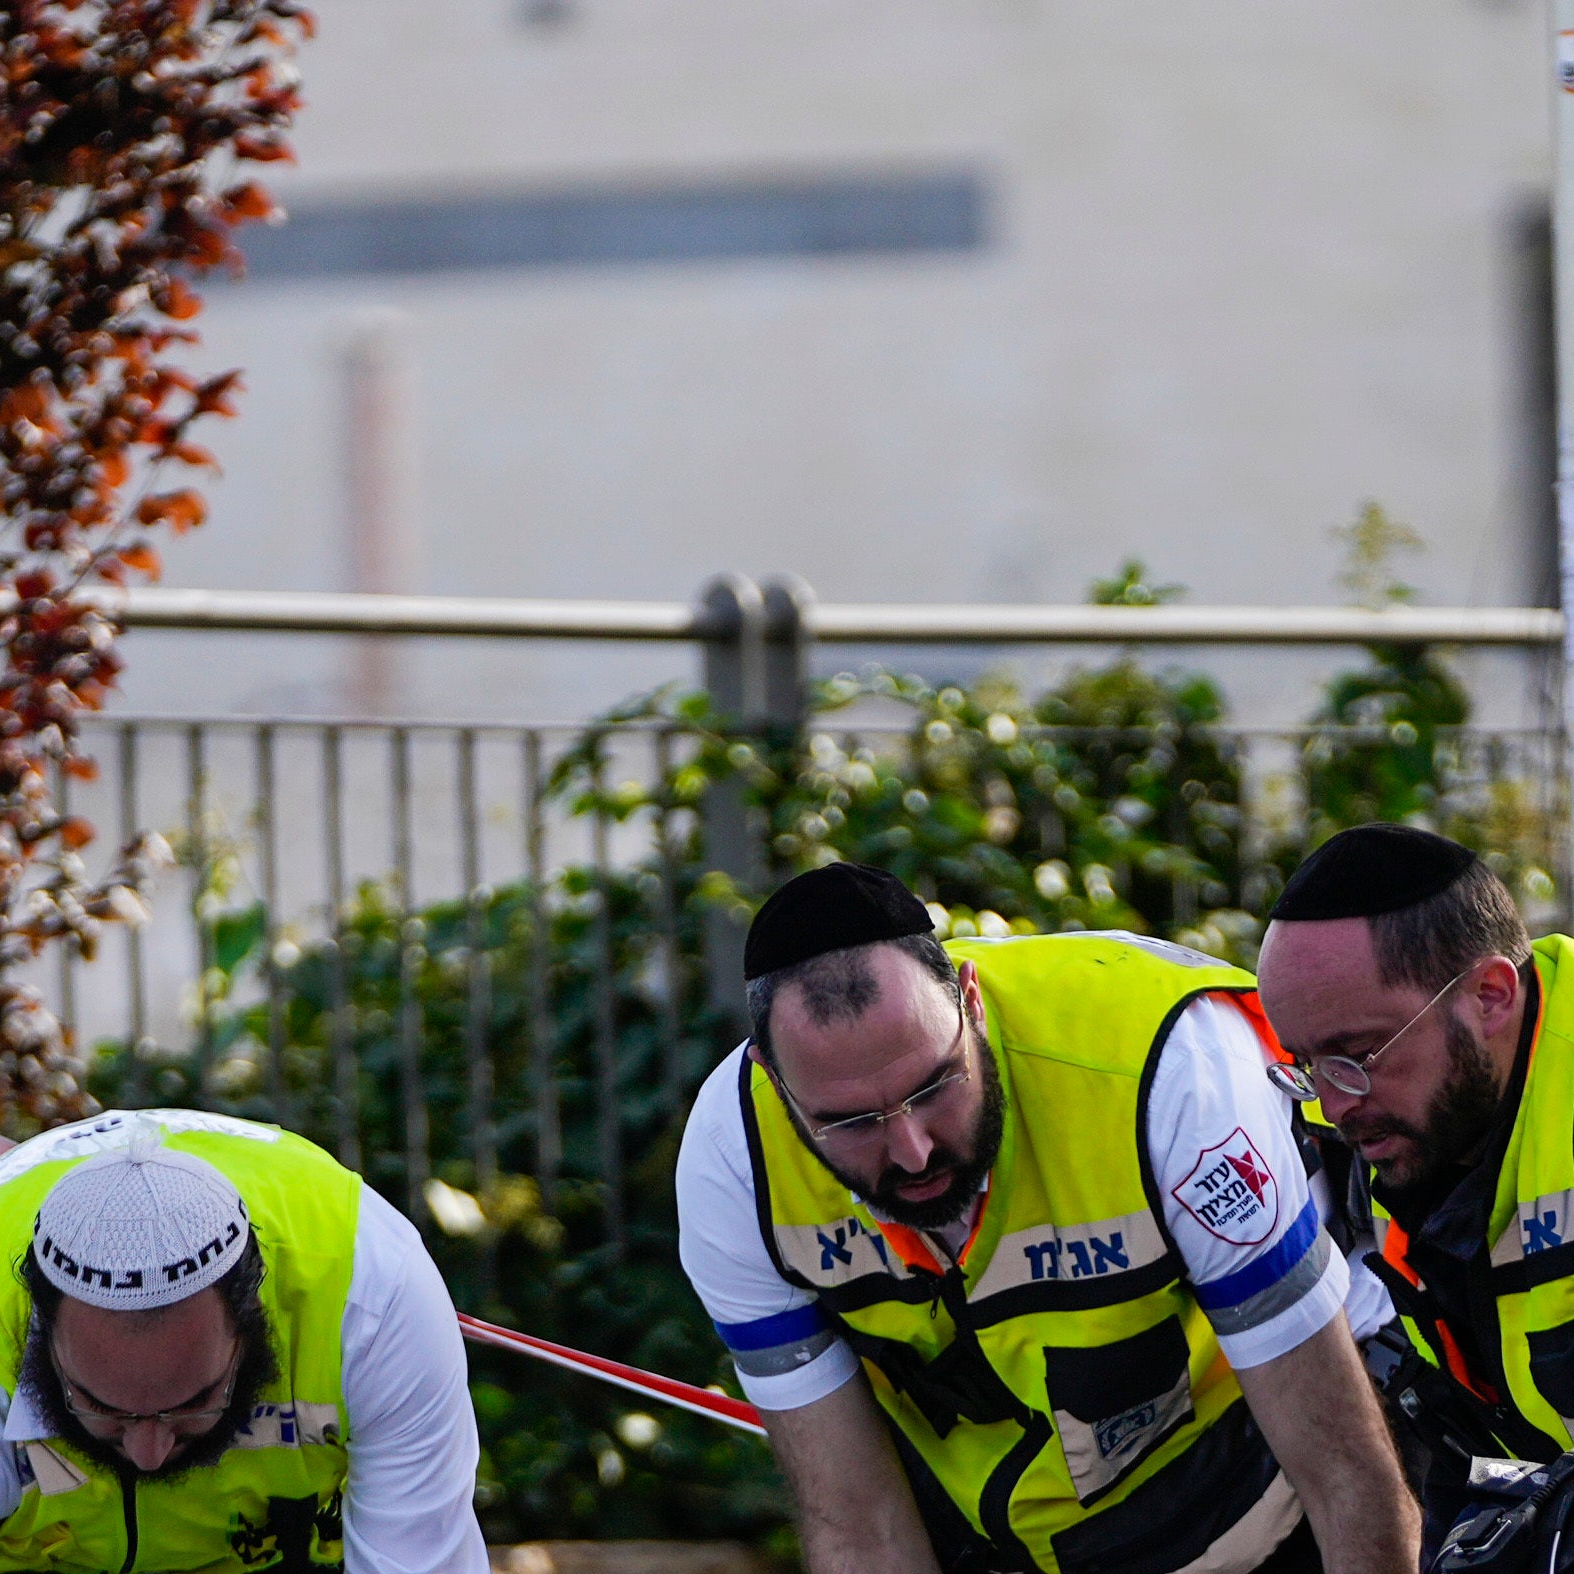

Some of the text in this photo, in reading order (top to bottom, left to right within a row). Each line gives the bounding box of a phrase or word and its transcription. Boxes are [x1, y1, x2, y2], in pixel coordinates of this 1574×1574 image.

[1193, 1160, 1235, 1198] עזר
[1196, 1177, 1253, 1229] מציון
[42, 1221, 241, 1289] נחמ נחמן
